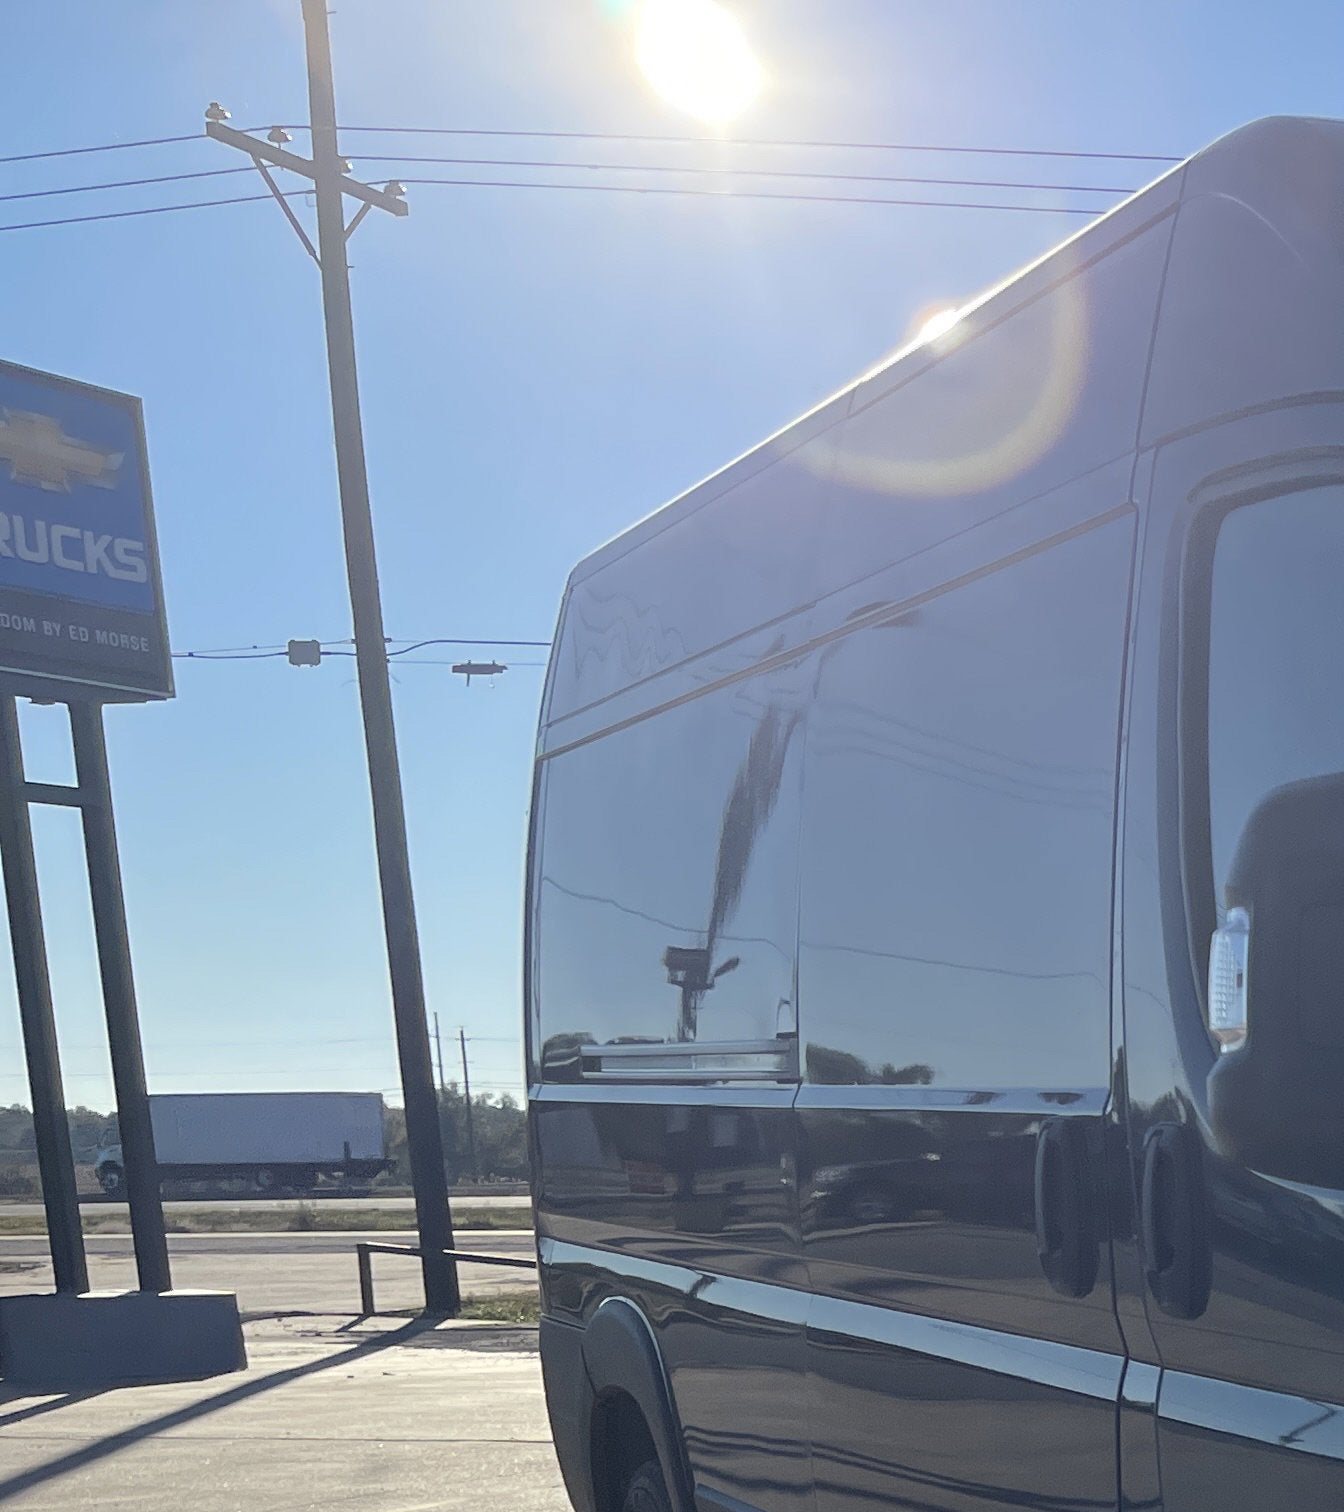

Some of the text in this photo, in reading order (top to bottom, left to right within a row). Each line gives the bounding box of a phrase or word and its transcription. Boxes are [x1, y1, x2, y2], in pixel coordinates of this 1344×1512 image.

[42, 620, 61, 637] BY
[68, 624, 89, 642] ED
[95, 630, 149, 652] MORSE
